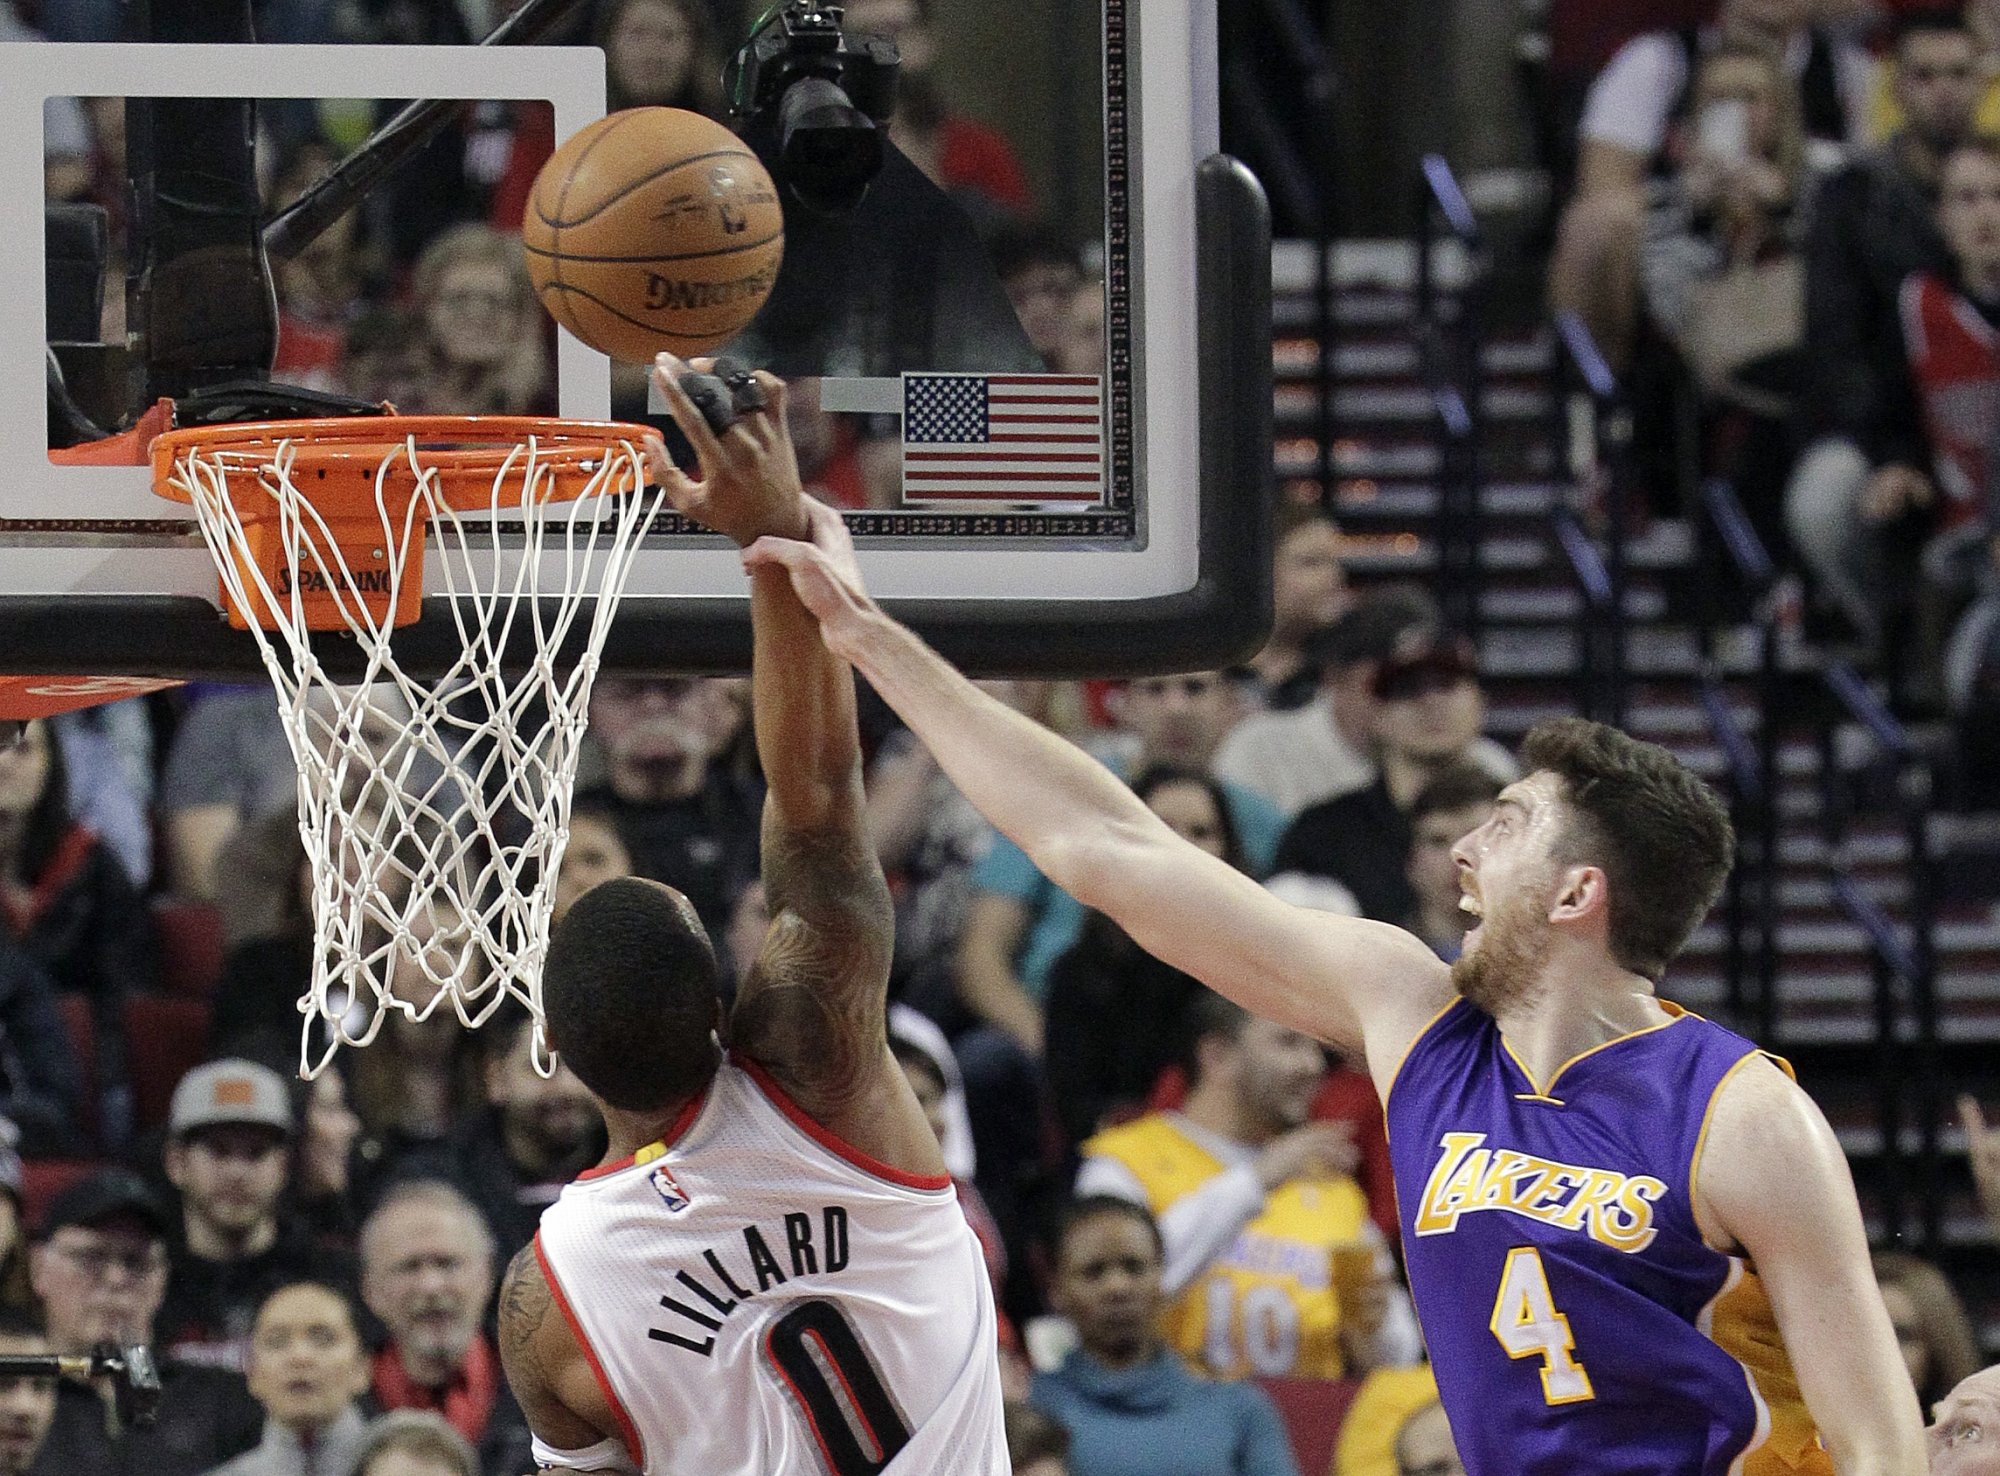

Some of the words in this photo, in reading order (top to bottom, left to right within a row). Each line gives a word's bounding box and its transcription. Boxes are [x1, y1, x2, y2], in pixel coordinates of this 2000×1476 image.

[1414, 1132, 1669, 1254] LAKERS
[649, 1206, 850, 1357] LILLARD
[1207, 1277, 1298, 1377] 10
[1490, 1246, 1595, 1406] 4
[758, 1297, 917, 1476] 0
